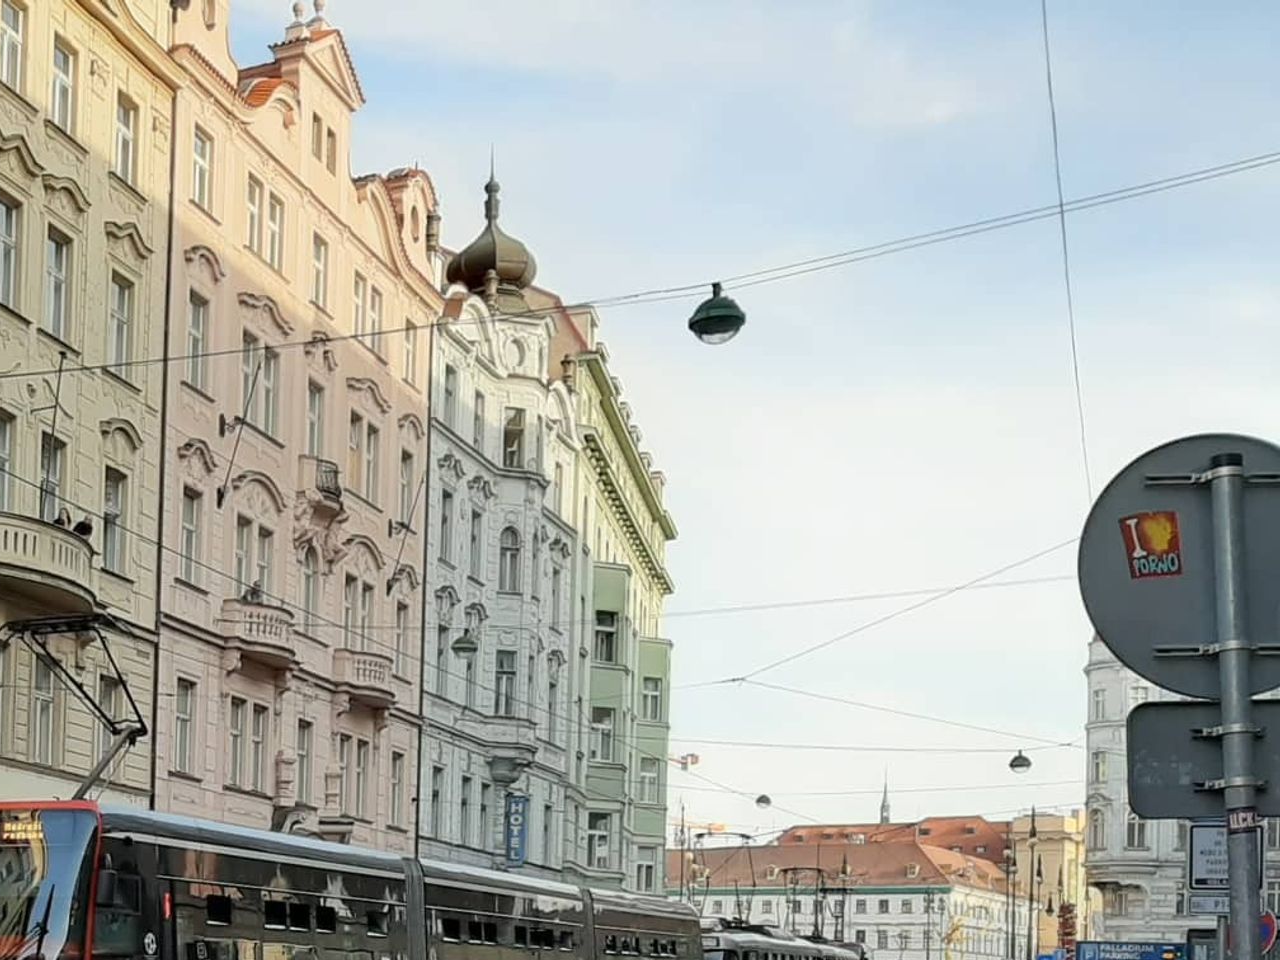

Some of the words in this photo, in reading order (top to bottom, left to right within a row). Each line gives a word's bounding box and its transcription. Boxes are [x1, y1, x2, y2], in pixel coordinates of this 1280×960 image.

[1126, 518, 1147, 558] I
[1132, 553, 1179, 577] PORNO
[509, 802, 524, 861] HOTEL
[1099, 952, 1141, 960] PARKING
